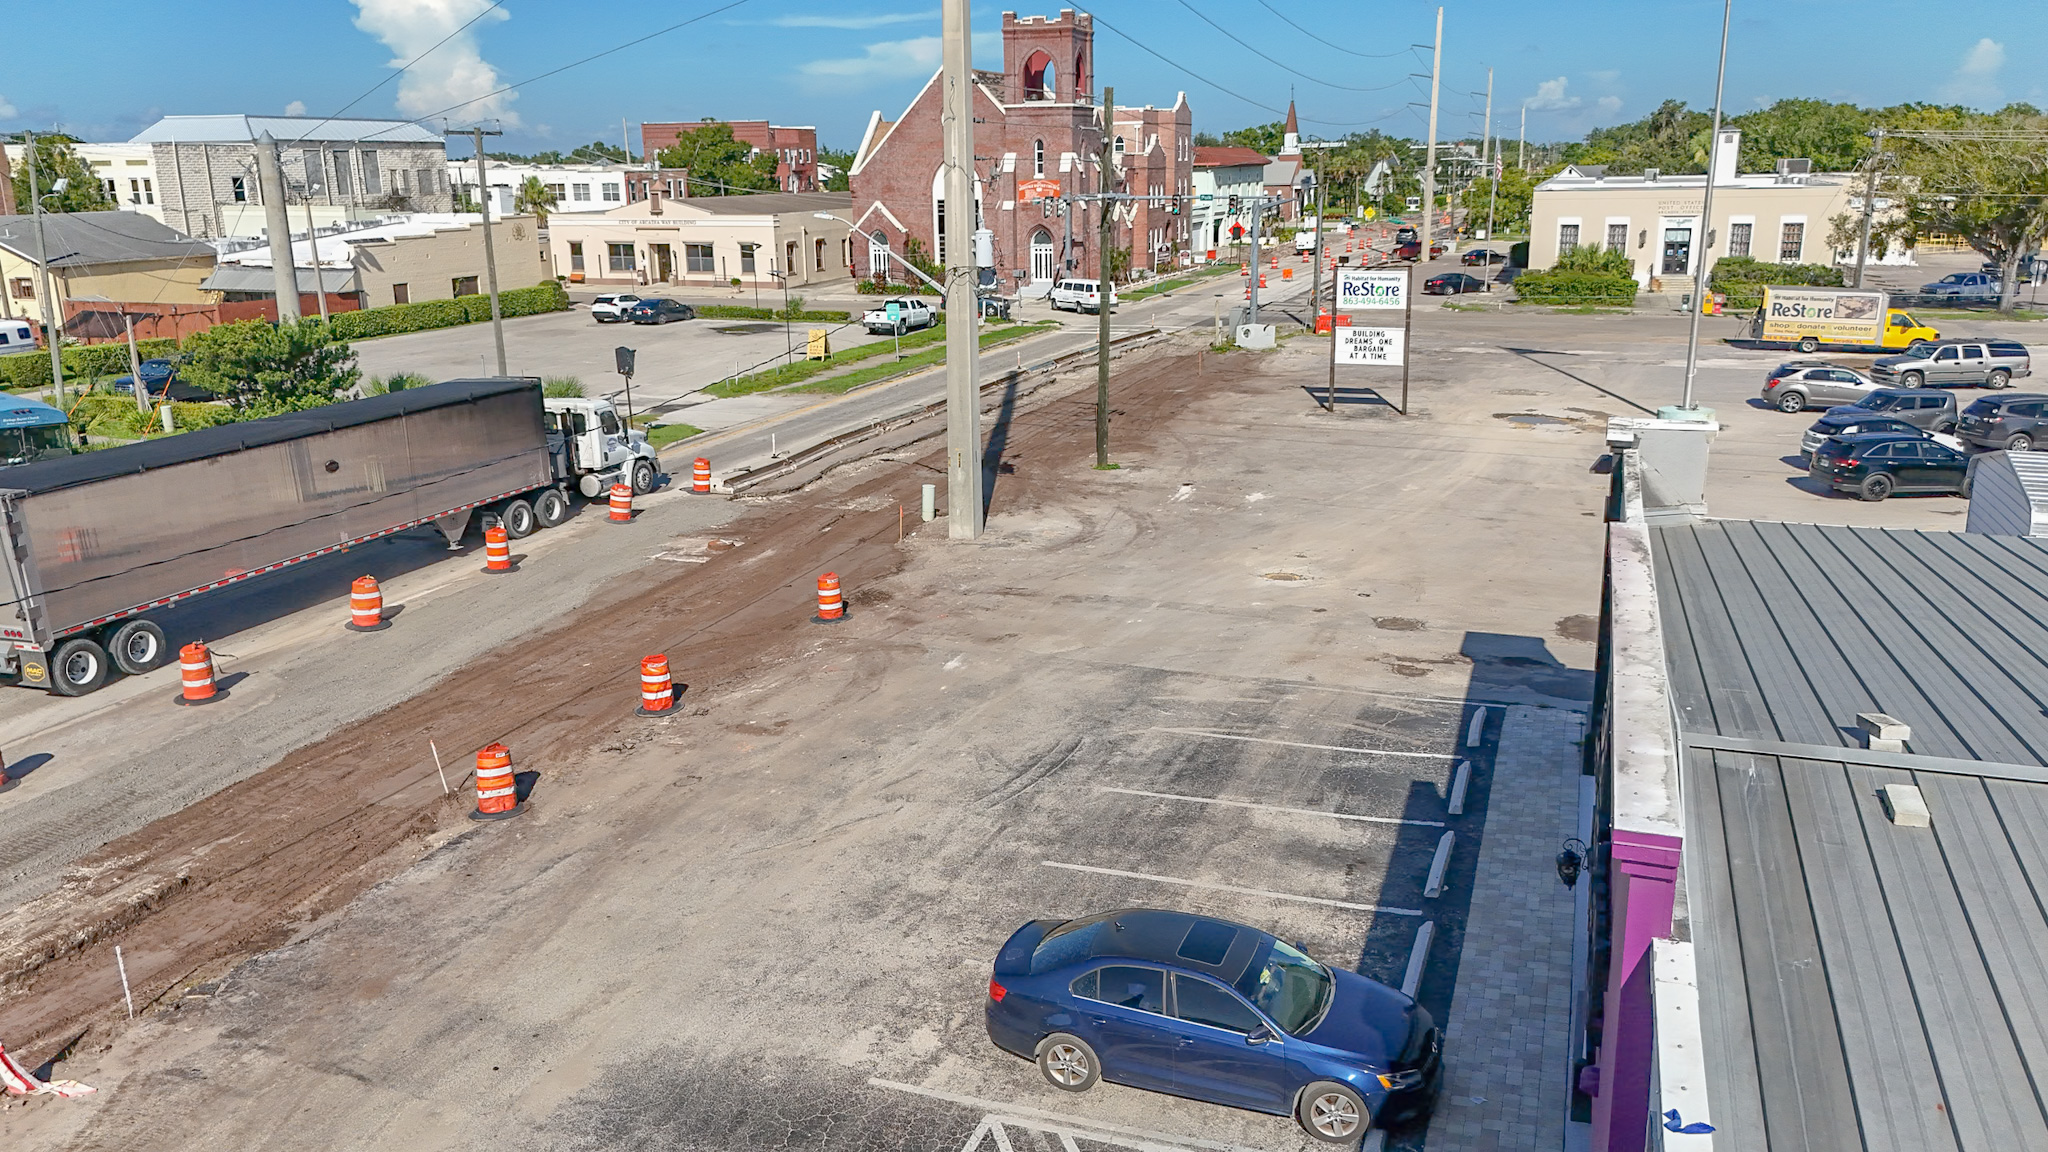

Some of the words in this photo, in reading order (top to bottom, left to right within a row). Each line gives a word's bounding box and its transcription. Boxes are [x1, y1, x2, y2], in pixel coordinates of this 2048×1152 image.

[1343, 281, 1400, 296] ReStore
[1343, 297, 1400, 305] 863-494-6456
[1771, 302, 1832, 318] ReStore
